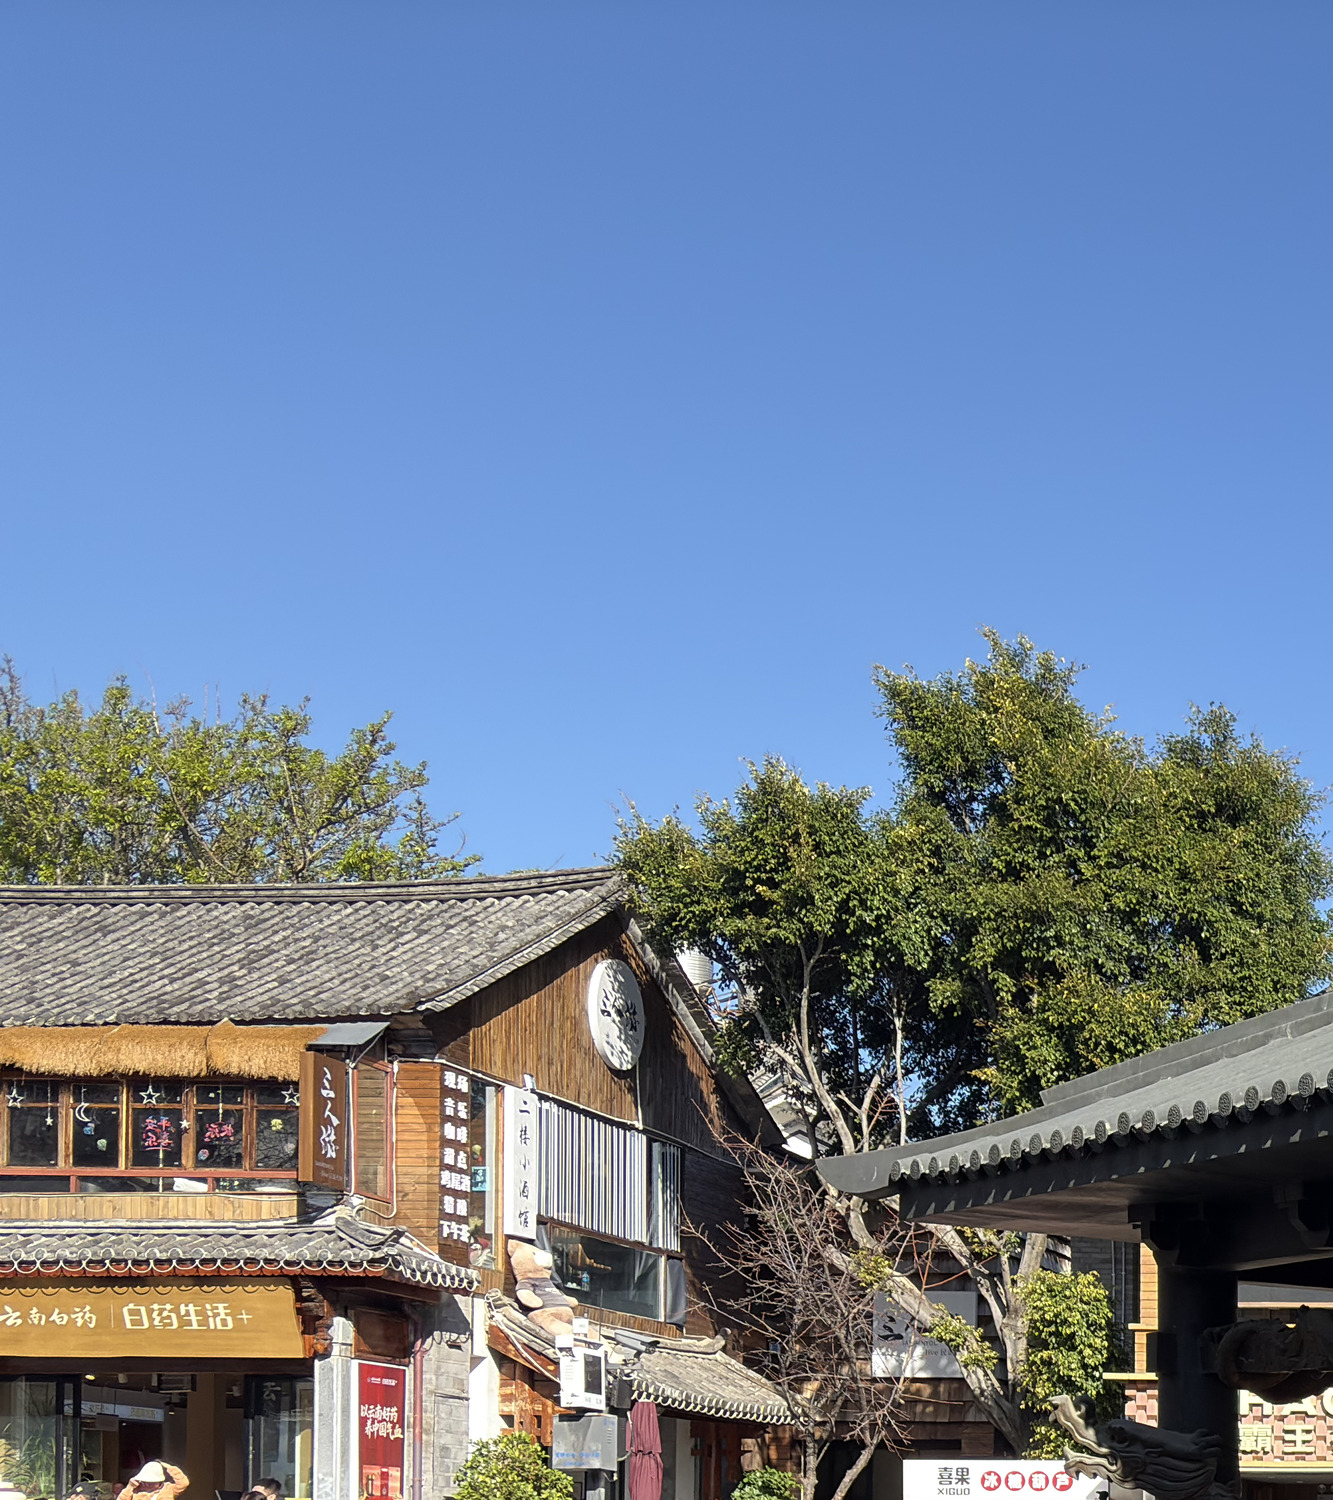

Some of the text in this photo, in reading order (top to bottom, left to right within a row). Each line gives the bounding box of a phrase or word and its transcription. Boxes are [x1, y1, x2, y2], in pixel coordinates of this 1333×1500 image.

[443, 1122, 468, 1144] 咖啡
[0, 1304, 97, 1329] 云南白药
[122, 1302, 253, 1330] 白药生活+
[937, 1467, 970, 1485] 喜果
[982, 1472, 1071, 1491] 冰糖葫芦
[937, 1487, 970, 1496] XIGUO
